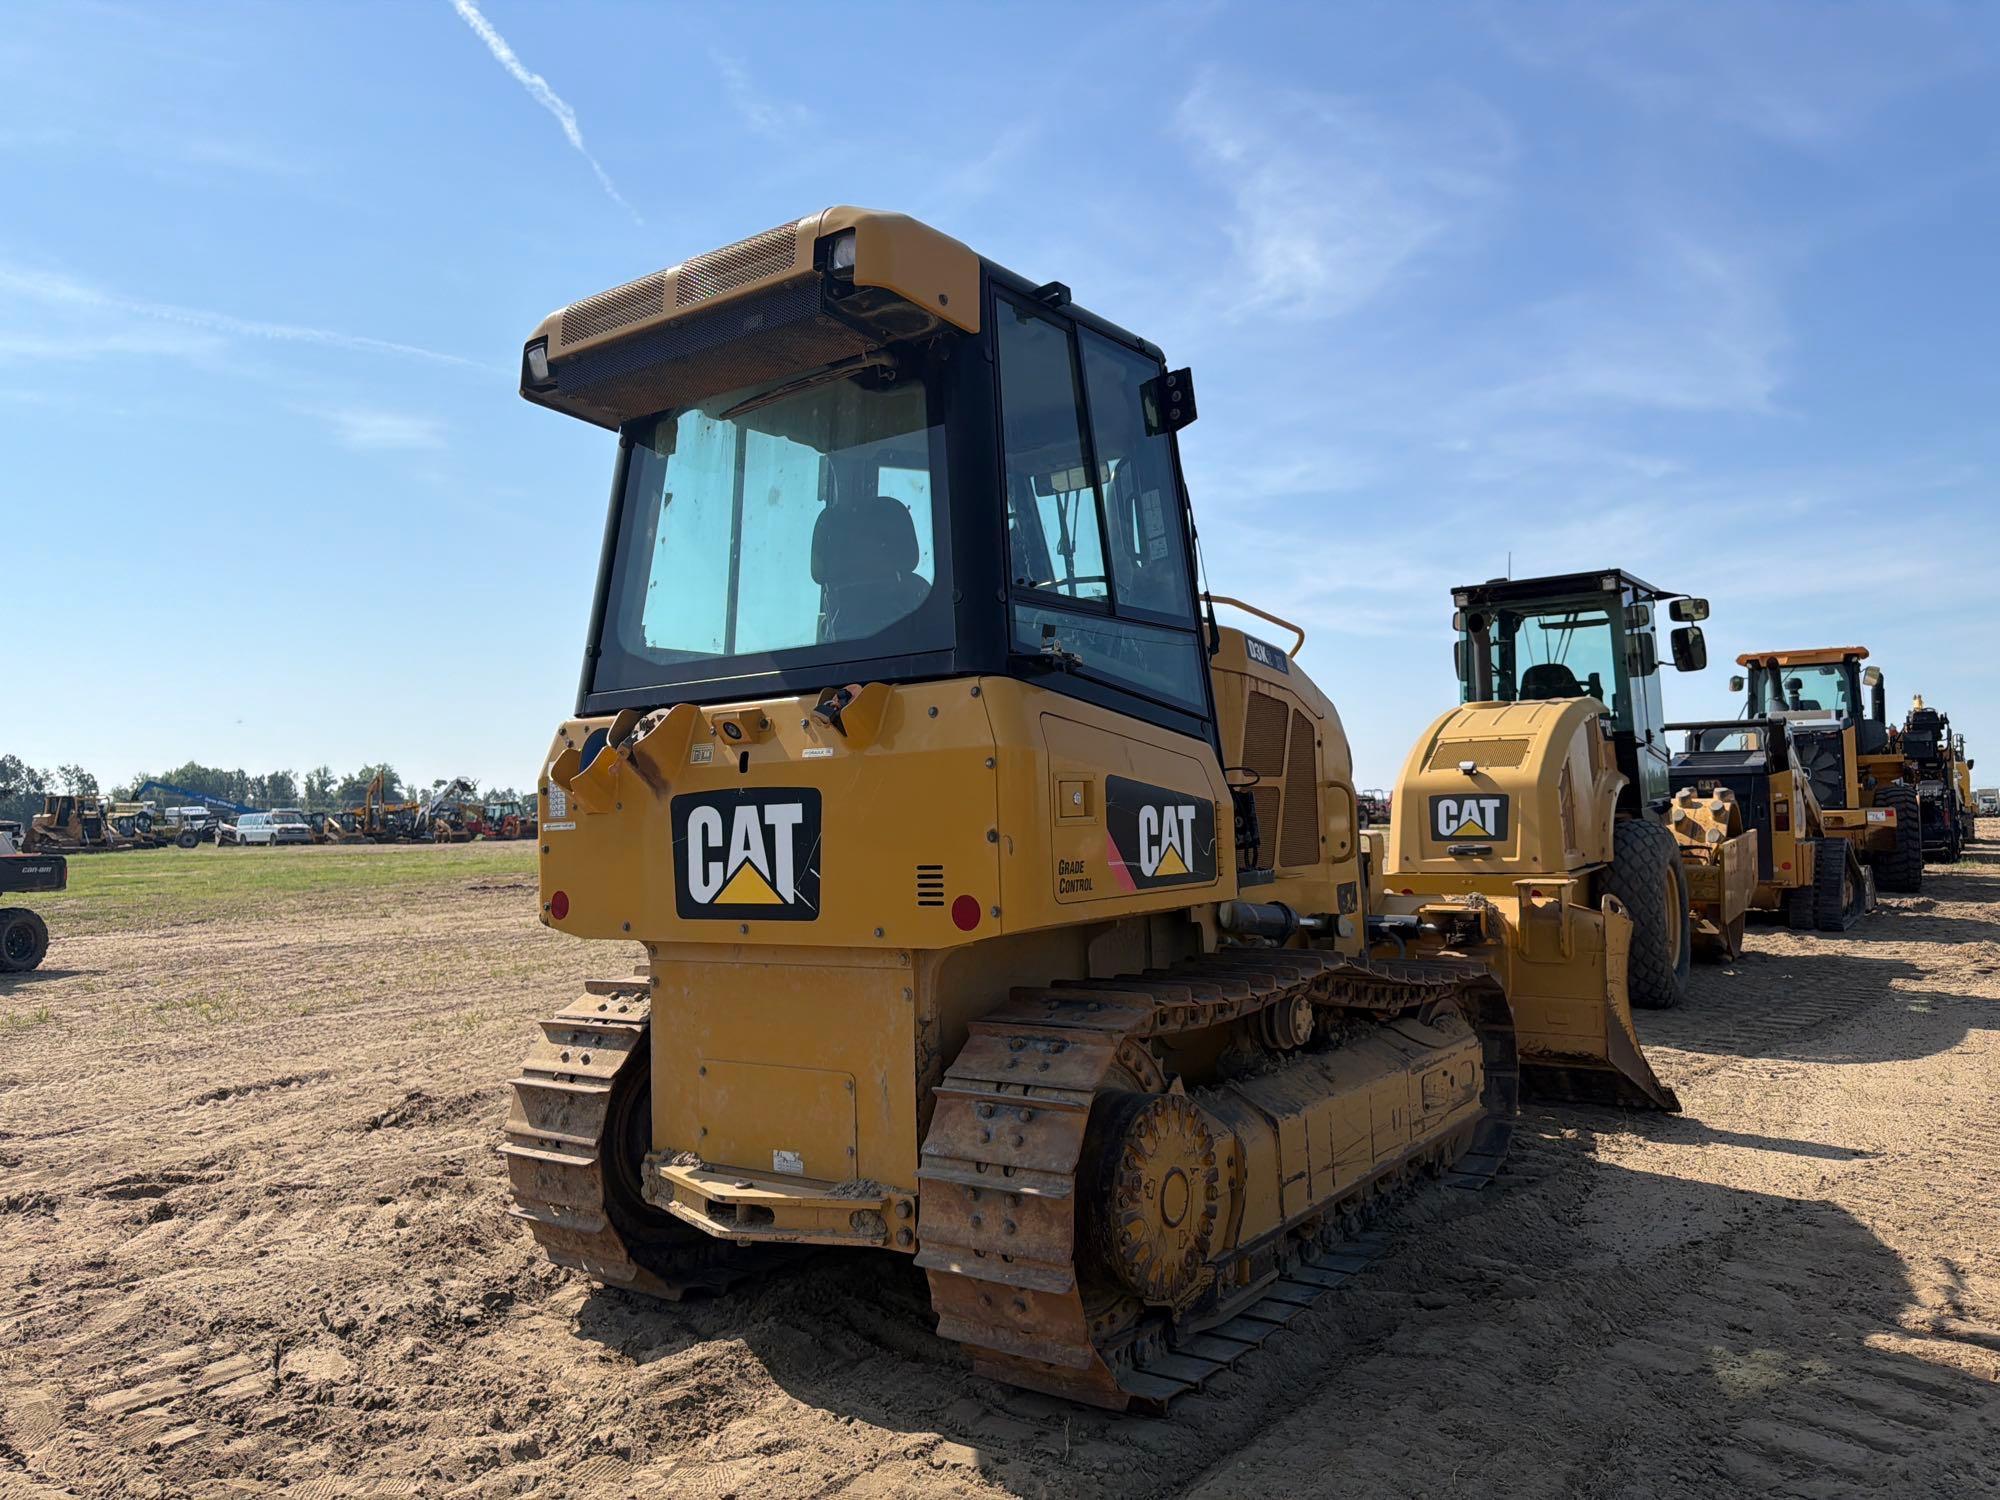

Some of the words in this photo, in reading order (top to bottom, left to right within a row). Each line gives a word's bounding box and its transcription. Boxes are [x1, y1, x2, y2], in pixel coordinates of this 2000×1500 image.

[1438, 799, 1500, 836] CAT
[687, 803, 803, 904] CAT
[1139, 805, 1195, 877] CAT
[1059, 860, 1085, 875] GRADE
[1059, 877, 1093, 894] CONTROL
